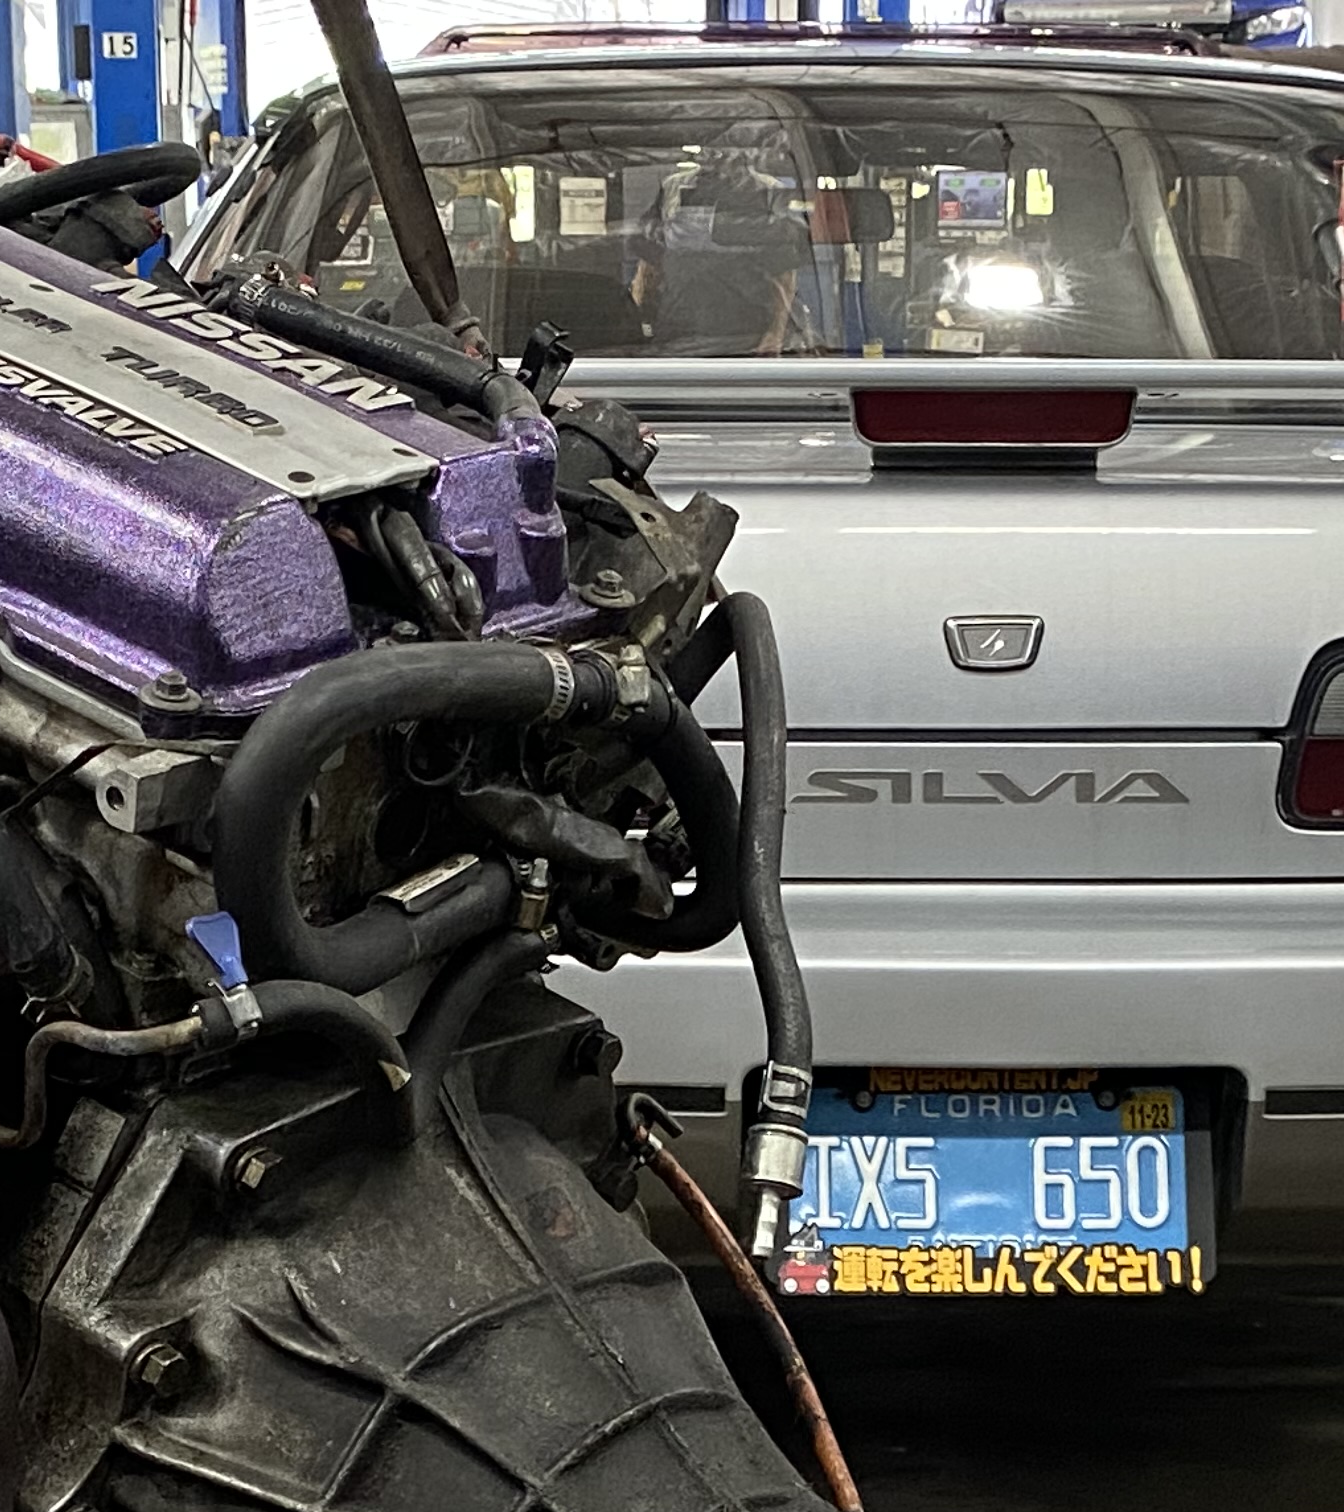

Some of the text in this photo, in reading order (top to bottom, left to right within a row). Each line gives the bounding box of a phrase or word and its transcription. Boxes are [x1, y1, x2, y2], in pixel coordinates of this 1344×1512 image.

[108, 35, 134, 56] 15
[90, 278, 415, 413] NISSAN
[100, 345, 282, 433] TURBO
[791, 769, 1191, 805] SILVIA
[893, 1094, 1078, 1119] FLORIDA
[1128, 1103, 1171, 1130] 11-23
[806, 1135, 1171, 1231] IX5 650
